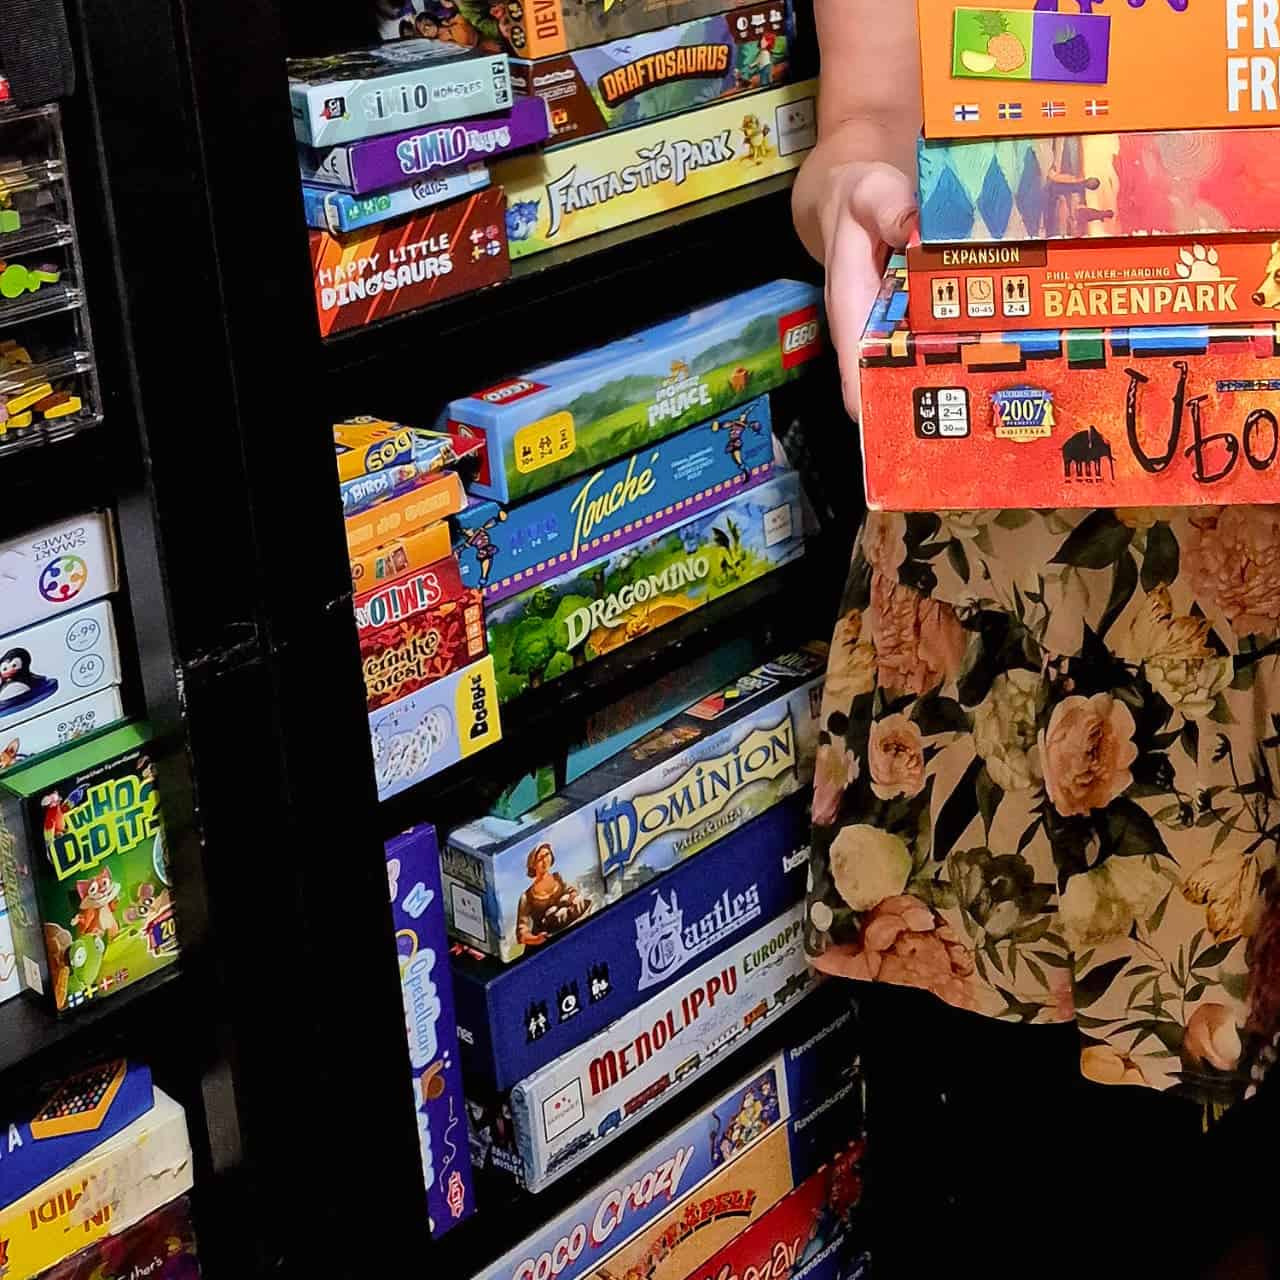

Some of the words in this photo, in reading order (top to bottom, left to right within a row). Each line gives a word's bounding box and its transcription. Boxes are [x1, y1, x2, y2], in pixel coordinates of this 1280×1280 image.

[602, 44, 730, 103] DRAFTOSAURUS
[411, 177, 449, 202] Pearls
[545, 144, 672, 238] FANTASTIC
[670, 129, 736, 186] PARK
[317, 254, 381, 287] HAPPY
[388, 232, 451, 265] LITTLE
[943, 247, 1020, 265] EXPANSION
[1045, 270, 1071, 280] PHIL
[1073, 266, 1171, 279] WALKER-HARDING
[319, 252, 455, 312] DINOSAURS
[1043, 281, 1239, 319] BÄRENPARK
[782, 320, 818, 355] LEGO
[1000, 399, 1044, 421] 2007
[569, 451, 661, 562] Touché
[31, 526, 86, 553] GAMES
[33, 535, 89, 563] SMART
[563, 555, 710, 652] DRAGOMINO
[78, 660, 95, 675] 60
[368, 660, 428, 695] orest
[69, 777, 135, 832] WHO
[596, 724, 793, 874] DOMINION
[161, 918, 176, 938] 20
[588, 965, 738, 1097] MENOLIPPU
[743, 918, 804, 976] EUROOPP
[590, 1144, 696, 1243] Crazy
